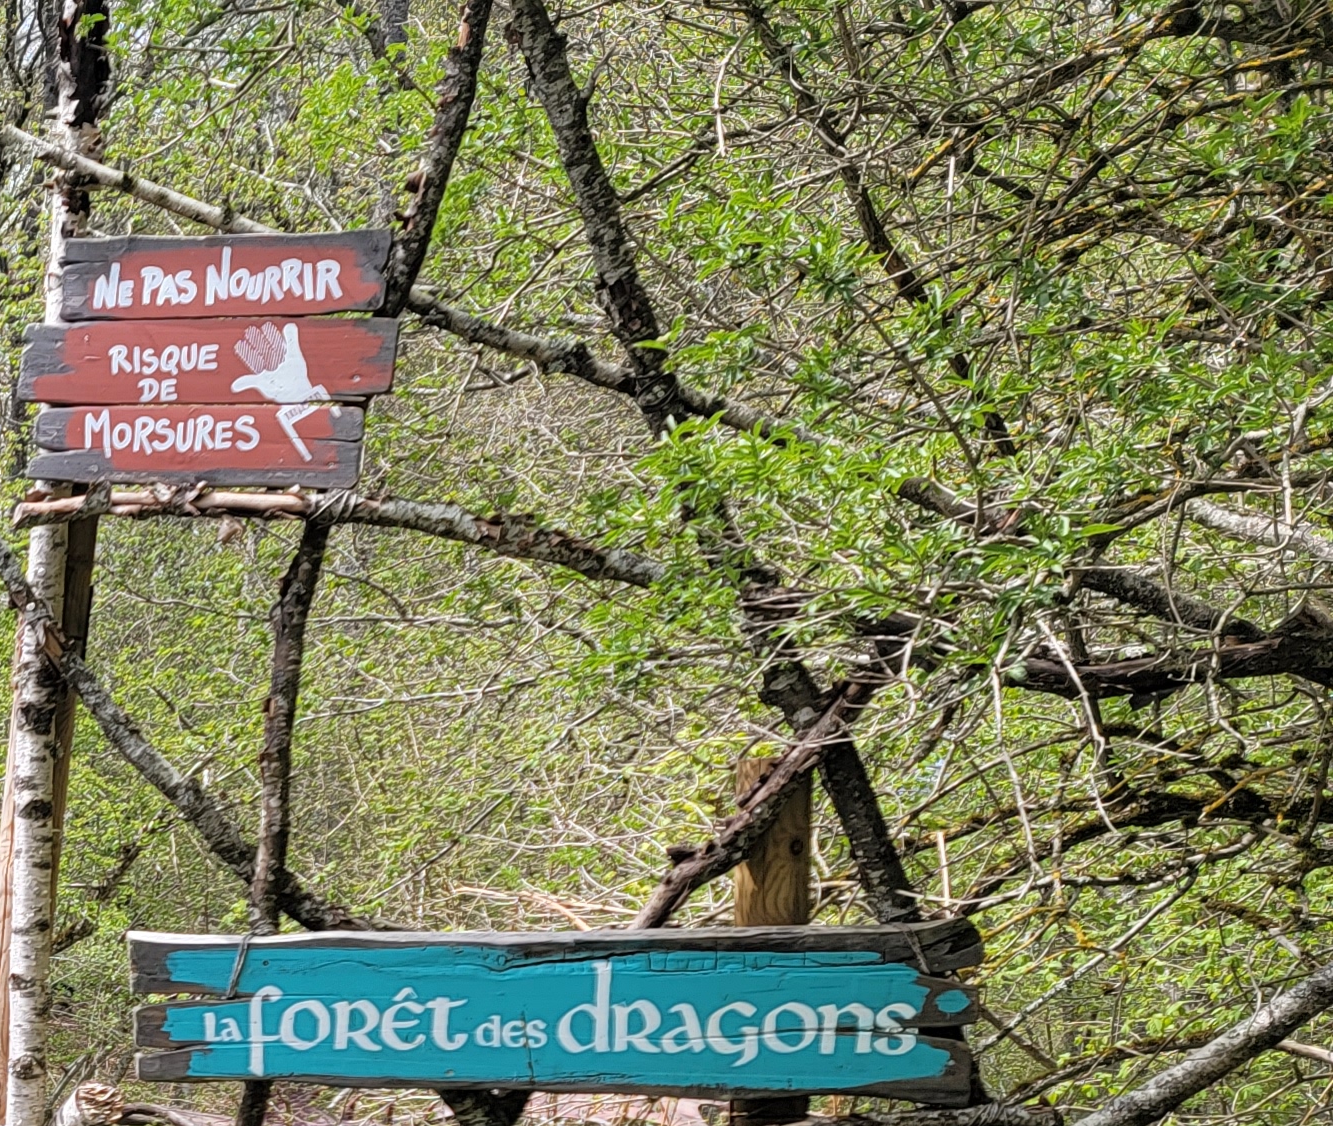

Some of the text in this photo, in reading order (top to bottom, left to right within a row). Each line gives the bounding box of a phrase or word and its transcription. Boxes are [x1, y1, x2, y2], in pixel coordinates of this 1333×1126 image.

[141, 266, 198, 306] PAS
[205, 246, 344, 307] NOURRIR
[108, 343, 220, 376] RISQUE
[137, 378, 179, 402] DE
[84, 409, 261, 459] MORSURES
